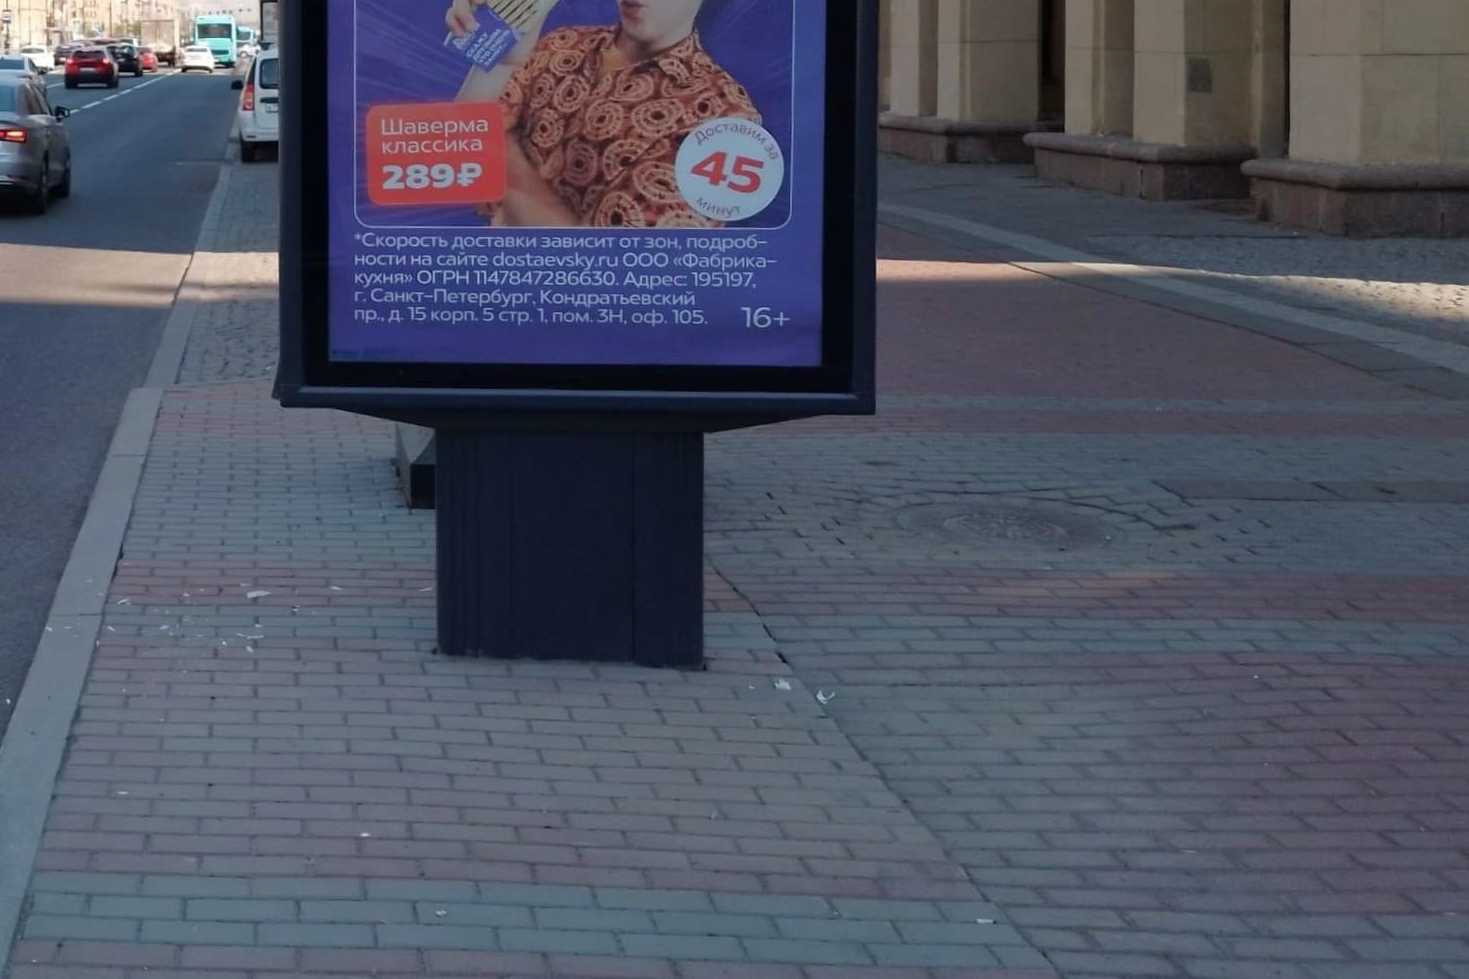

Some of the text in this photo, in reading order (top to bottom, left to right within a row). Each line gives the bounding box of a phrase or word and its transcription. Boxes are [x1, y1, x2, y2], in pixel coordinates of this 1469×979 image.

[381, 117, 489, 135] Шаверма
[382, 136, 483, 153] классика
[694, 124, 778, 160] Доставим за
[382, 163, 482, 189] 289₽
[691, 151, 764, 193] 45
[696, 197, 740, 218] минут
[452, 235, 536, 249] доставки
[542, 234, 615, 249] зависит
[619, 237, 640, 248] от
[644, 237, 682, 250] зон,
[354, 255, 406, 266] ности
[411, 255, 432, 266] на
[437, 251, 488, 266] сайте
[492, 251, 618, 269] dostaevsky.ru
[623, 252, 668, 267] ООО
[354, 270, 756, 289] кухня» ОГРН 1147847286630. Адрес: 195197,
[354, 291, 366, 302] г.
[541, 290, 695, 307] Кондратьевский
[388, 310, 404, 323] д.
[408, 307, 426, 321] 15
[431, 310, 477, 325] корп.
[483, 308, 493, 321] 5
[499, 311, 532, 325] стр.
[553, 311, 593, 323] пом.
[632, 310, 667, 326] оф.
[672, 310, 708, 324] 105.
[741, 307, 790, 328] 16+
